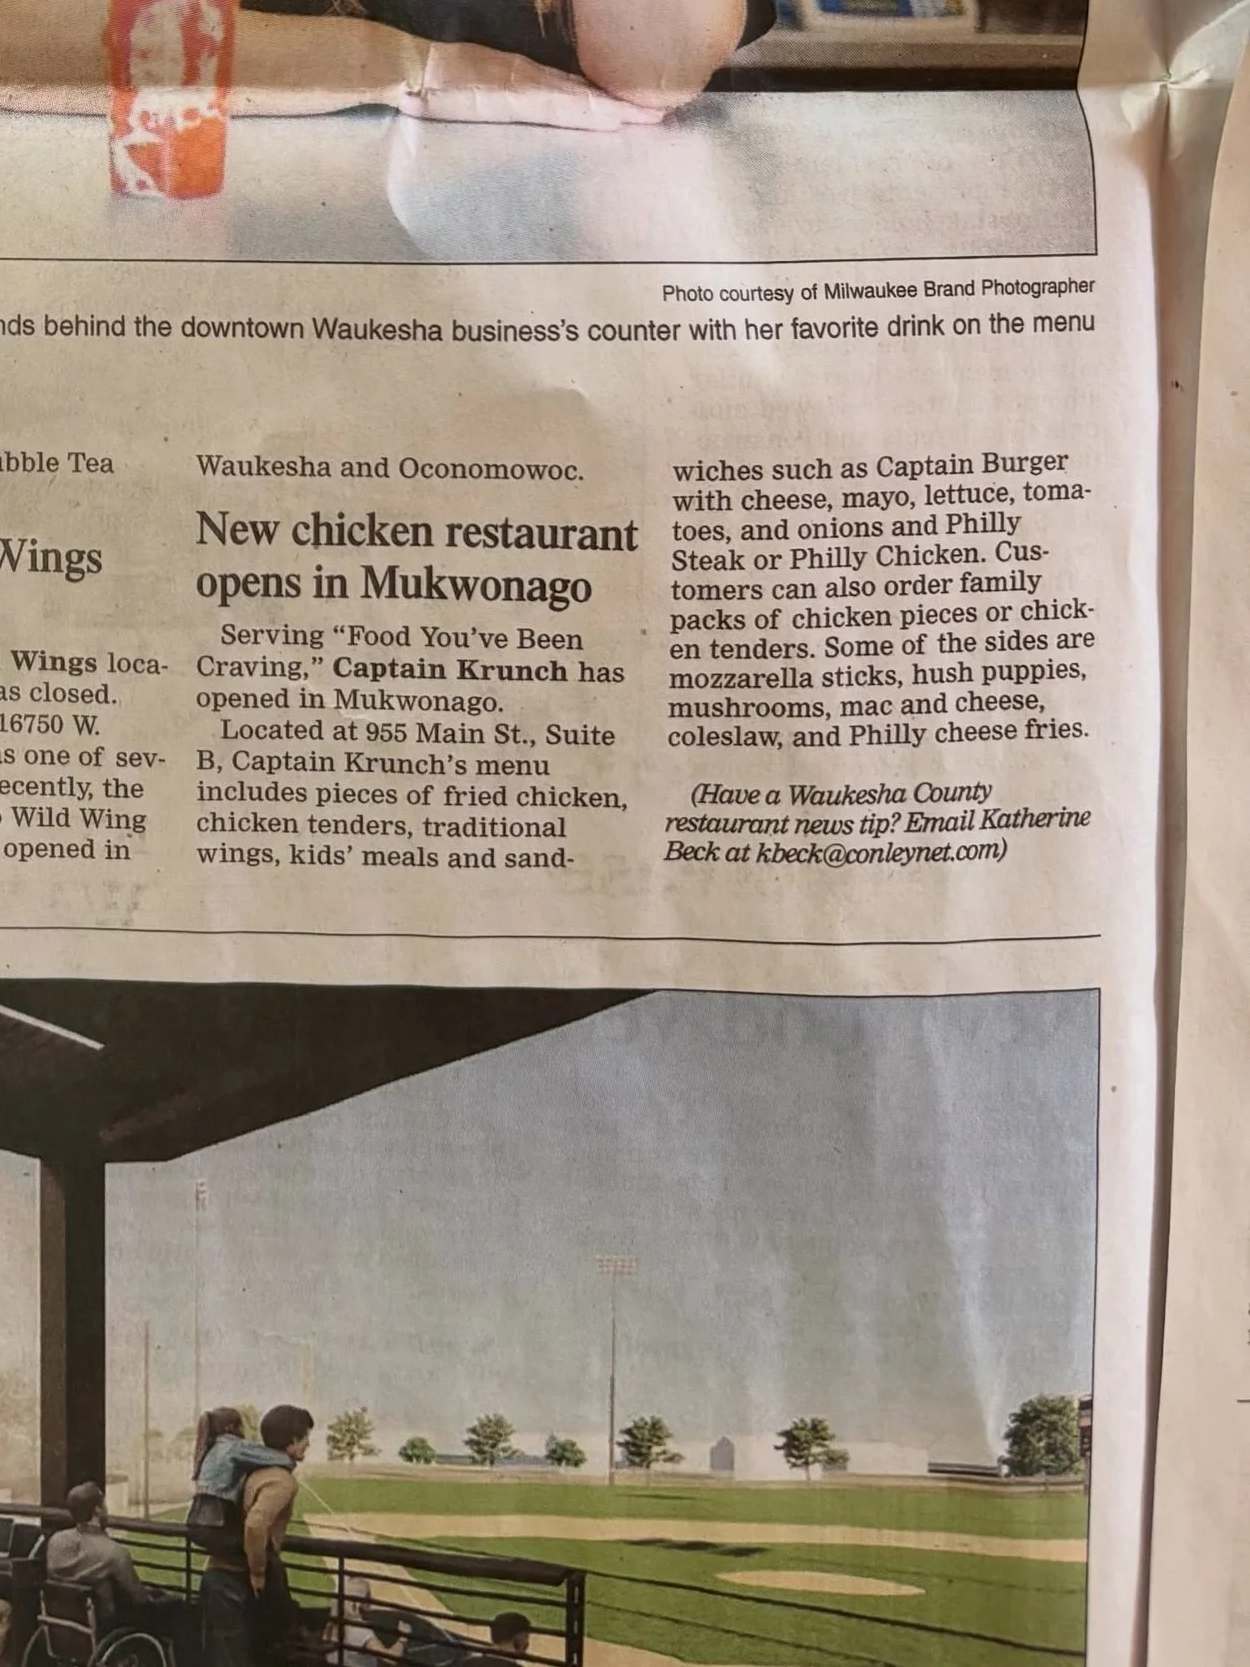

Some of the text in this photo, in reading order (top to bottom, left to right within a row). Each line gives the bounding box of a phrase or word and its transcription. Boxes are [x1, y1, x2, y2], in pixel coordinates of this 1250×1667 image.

[663, 277, 1095, 305] Photo courtesy of Milwaukee Brand Photographer
[45, 314, 125, 336] behind
[134, 315, 172, 337] the
[181, 316, 304, 339] downtown
[312, 317, 443, 341] Waukesha
[588, 320, 681, 341] counter
[689, 318, 736, 340] with
[745, 319, 783, 340] her
[791, 316, 878, 339] favorite
[888, 314, 945, 337] drink
[953, 318, 980, 335] on
[989, 320, 1024, 336] the
[1034, 315, 1094, 332] menu
[196, 455, 584, 480] Waukesha and Oconomowoc.
[196, 510, 638, 552] New chicken restaurant
[197, 564, 592, 612] opens in Mukwonago
[669, 658, 1086, 688] mozzarella sticks, hush puppies,
[72, 714, 99, 735] W.
[664, 838, 1008, 868] Beck at kbeck@conleynet.com)
